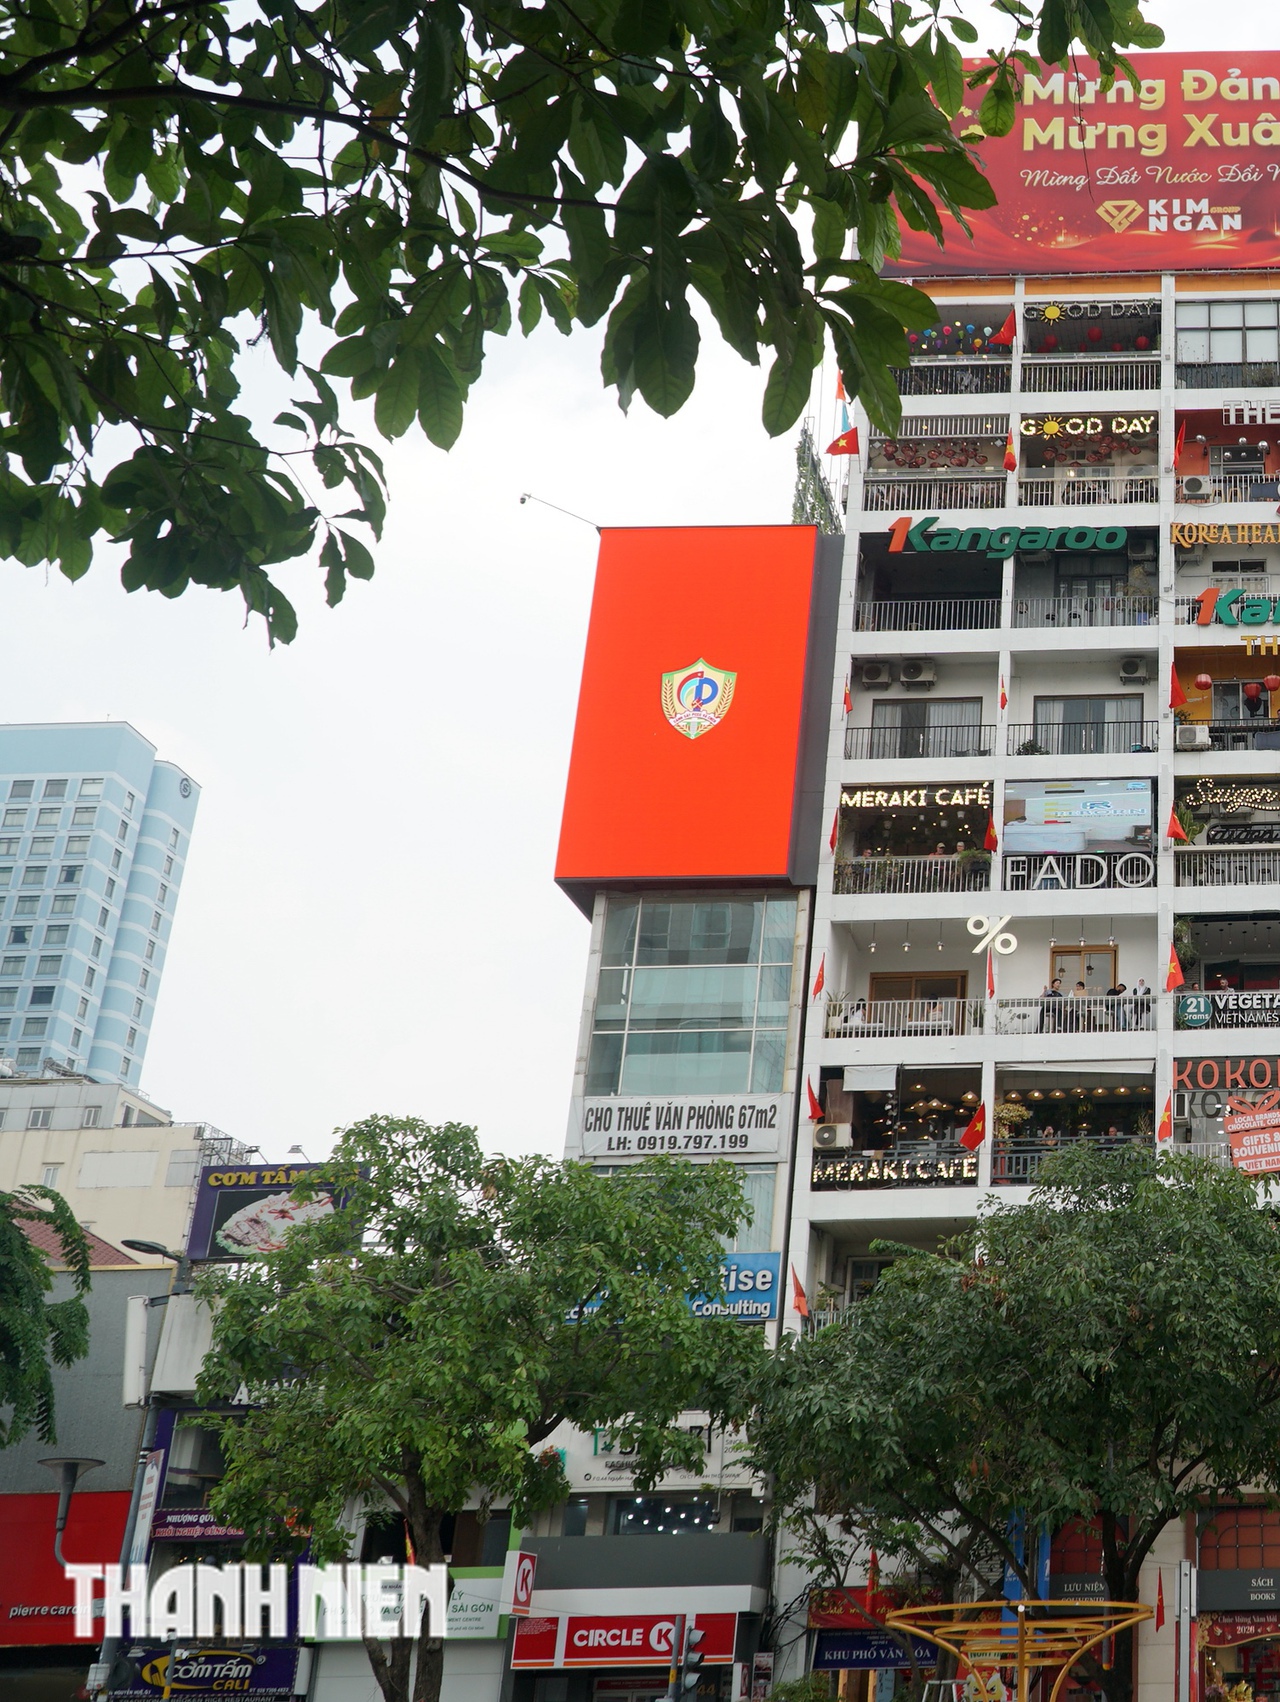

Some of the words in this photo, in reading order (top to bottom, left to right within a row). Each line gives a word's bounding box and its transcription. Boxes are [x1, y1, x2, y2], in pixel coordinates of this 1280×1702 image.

[1022, 70, 1166, 111] Mừng
[1022, 113, 1167, 157] Mừng
[1020, 167, 1089, 190] Mừng
[1095, 166, 1141, 187] Đất
[1146, 162, 1212, 186] Nước
[1217, 161, 1262, 185] Đổi
[1148, 198, 1210, 216] KIM
[1148, 215, 1242, 231] NGAN
[1111, 300, 1156, 318] DAY
[1111, 415, 1155, 435] DAY
[1170, 520, 1233, 549] KOREA
[841, 790, 927, 809] MERAKI
[1006, 853, 1155, 890] FADO
[1187, 995, 1205, 1013] 21
[585, 1107, 612, 1132] CHO
[617, 1101, 651, 1132] THUÊ
[655, 1102, 684, 1131] VĂN
[686, 1100, 734, 1130] PHÒNG
[738, 1104, 777, 1129] 67m2
[1234, 1115, 1254, 1124] LOCAL
[1255, 1112, 1280, 1121] BRANDS
[1227, 1121, 1266, 1131] CHOCOLATE,
[607, 1136, 631, 1150] LH:
[637, 1134, 749, 1150] 0919.797.199
[1242, 1133, 1272, 1146] GIFTS
[208, 1171, 258, 1186] CƠM
[812, 1159, 909, 1182] MERAKI
[692, 1300, 771, 1317] Consulting
[1064, 1583, 1081, 1592] LƯU
[1251, 1577, 1274, 1587] SÁCH
[1250, 1593, 1276, 1601] BOOKS
[9, 1604, 49, 1618] pierre
[573, 1629, 643, 1647] CIRCLE
[824, 1651, 849, 1660] KHU
[852, 1646, 877, 1660] PHỐ
[879, 1648, 903, 1658] VĂN
[212, 1678, 250, 1691] CALI
